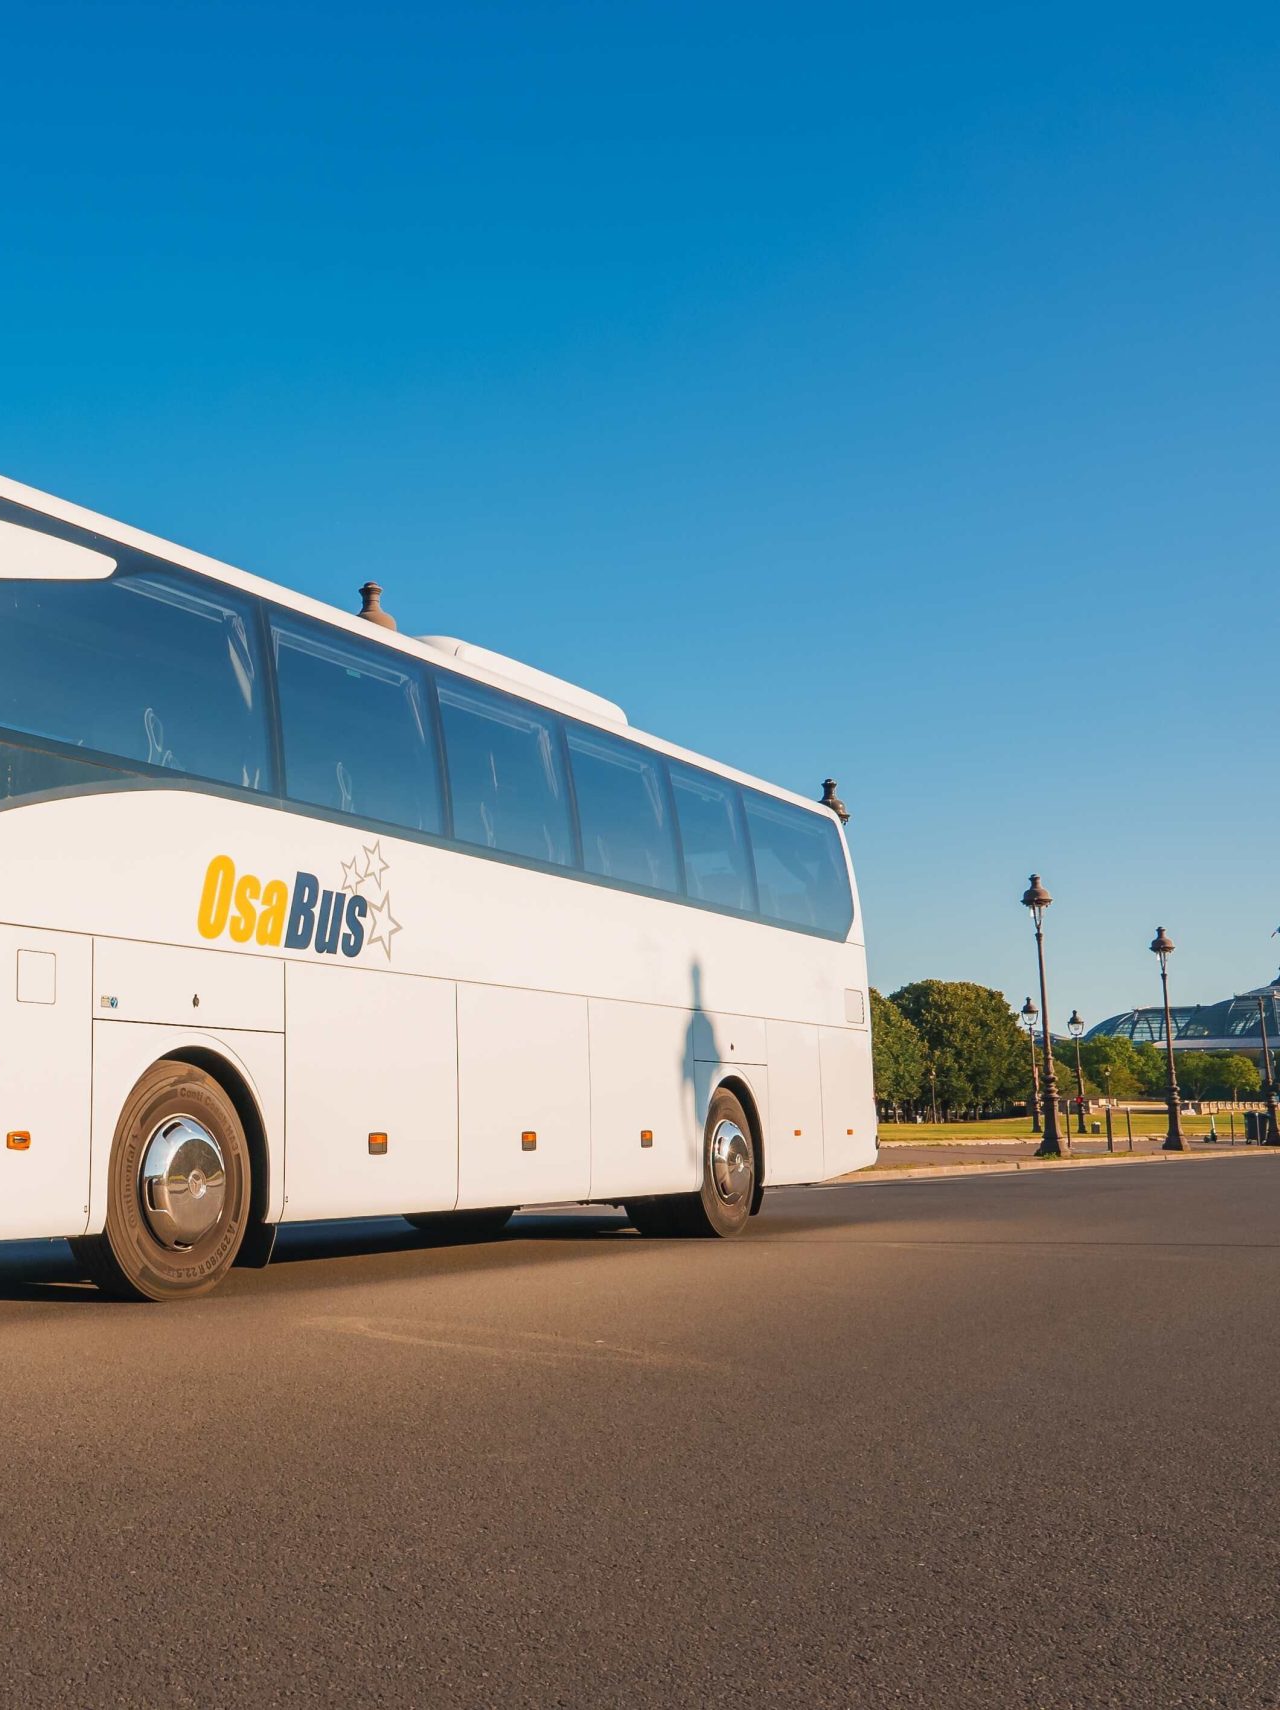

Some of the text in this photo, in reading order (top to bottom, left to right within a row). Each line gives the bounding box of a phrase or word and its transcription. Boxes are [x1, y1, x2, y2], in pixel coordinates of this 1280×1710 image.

[197, 854, 368, 958] OsaBus
[179, 1087, 203, 1102] Conti
[124, 1147, 137, 1229] Continental
